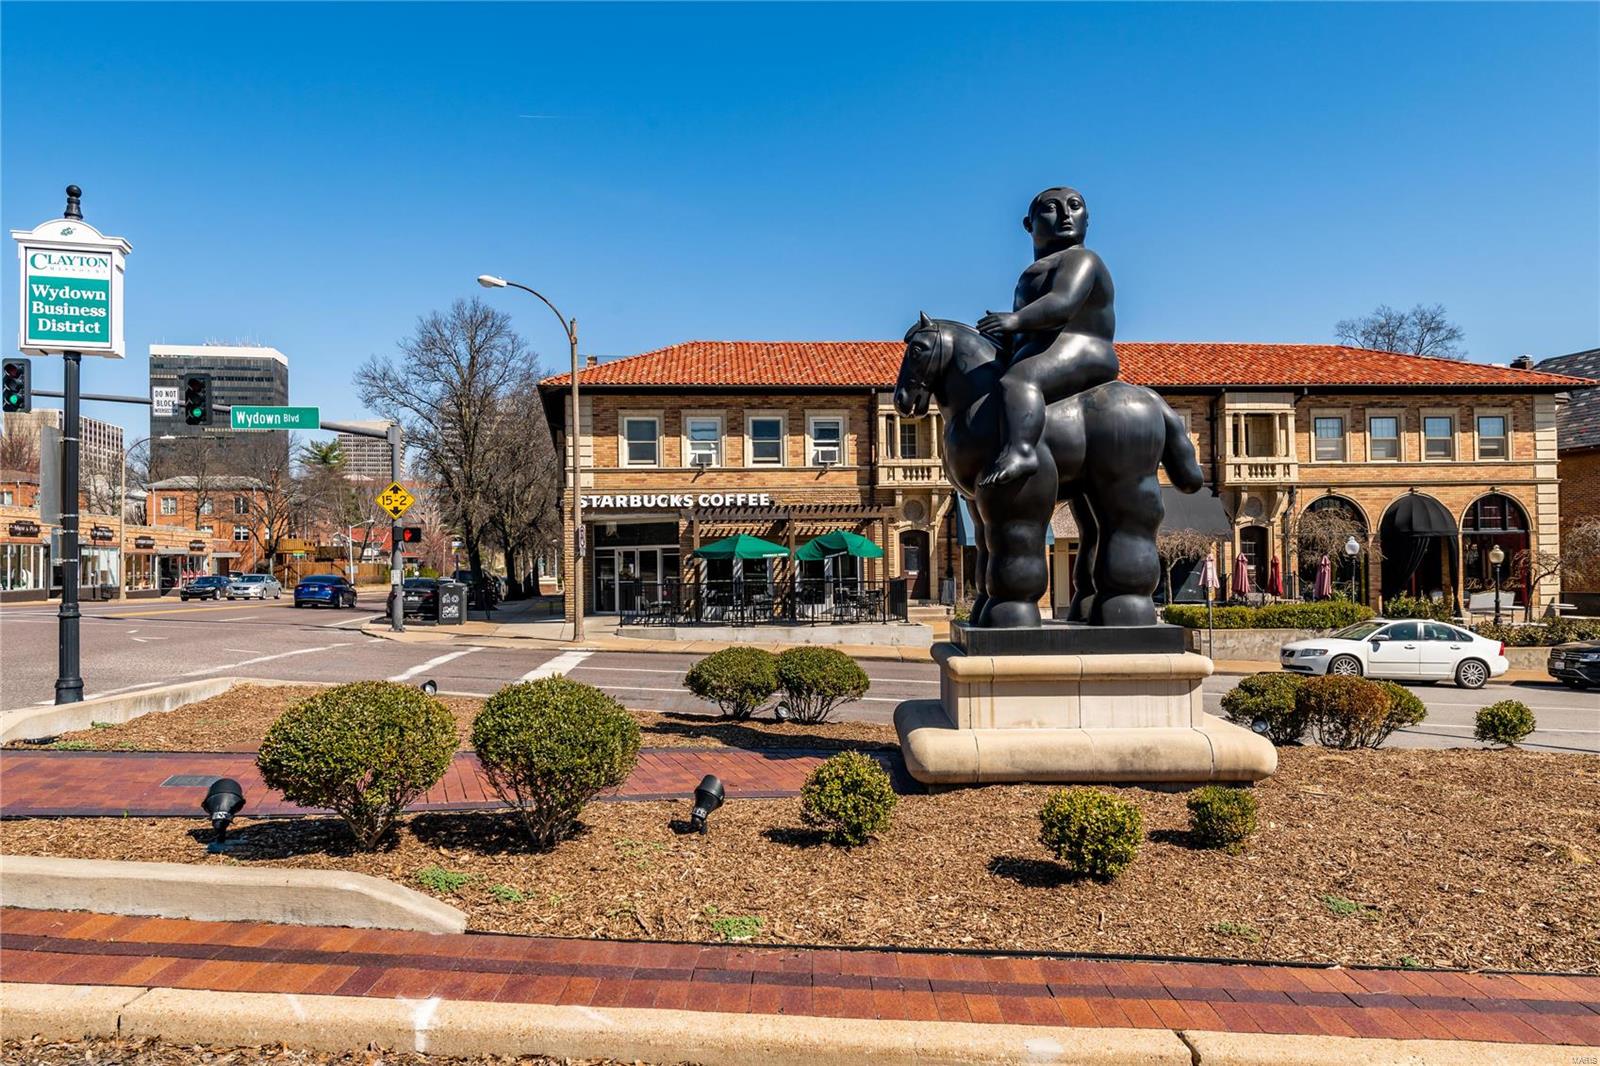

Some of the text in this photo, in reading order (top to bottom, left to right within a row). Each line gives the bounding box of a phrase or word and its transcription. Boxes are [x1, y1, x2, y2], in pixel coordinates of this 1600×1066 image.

[30, 253, 108, 270] CLAYTON
[31, 284, 107, 301] Wydown
[31, 301, 107, 317] Business
[37, 318, 101, 334] District
[236, 411, 300, 427] Wydown Blvd
[381, 495, 407, 506] 15-2
[580, 493, 770, 508] STARBUCKS COFFEE
